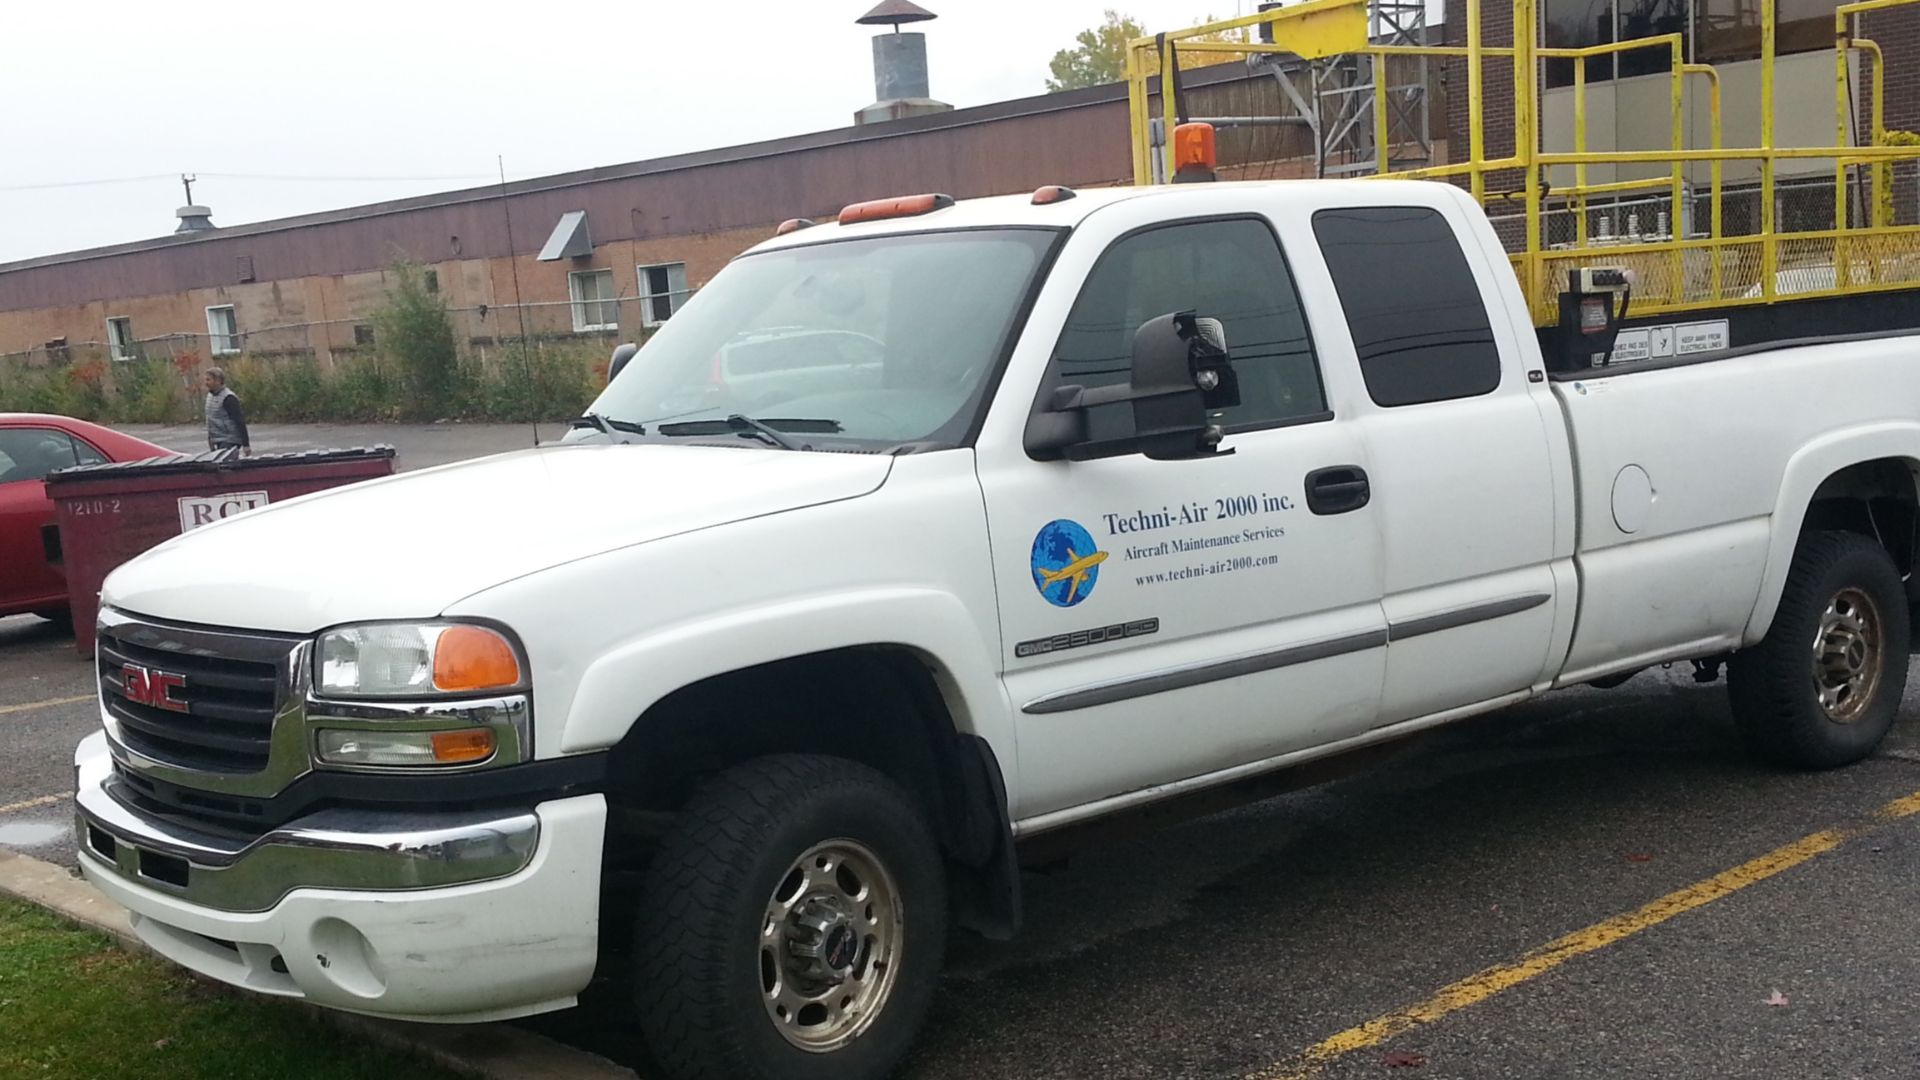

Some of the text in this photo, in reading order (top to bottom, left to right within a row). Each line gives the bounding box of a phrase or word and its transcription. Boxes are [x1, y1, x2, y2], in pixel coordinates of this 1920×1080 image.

[1103, 492, 1295, 535] Techni-Air 2000 inc.
[1124, 526, 1285, 561] Aircraft Maintenance Services
[1136, 554, 1278, 586] www.techni-air2000.com
[123, 663, 190, 713] GMC
